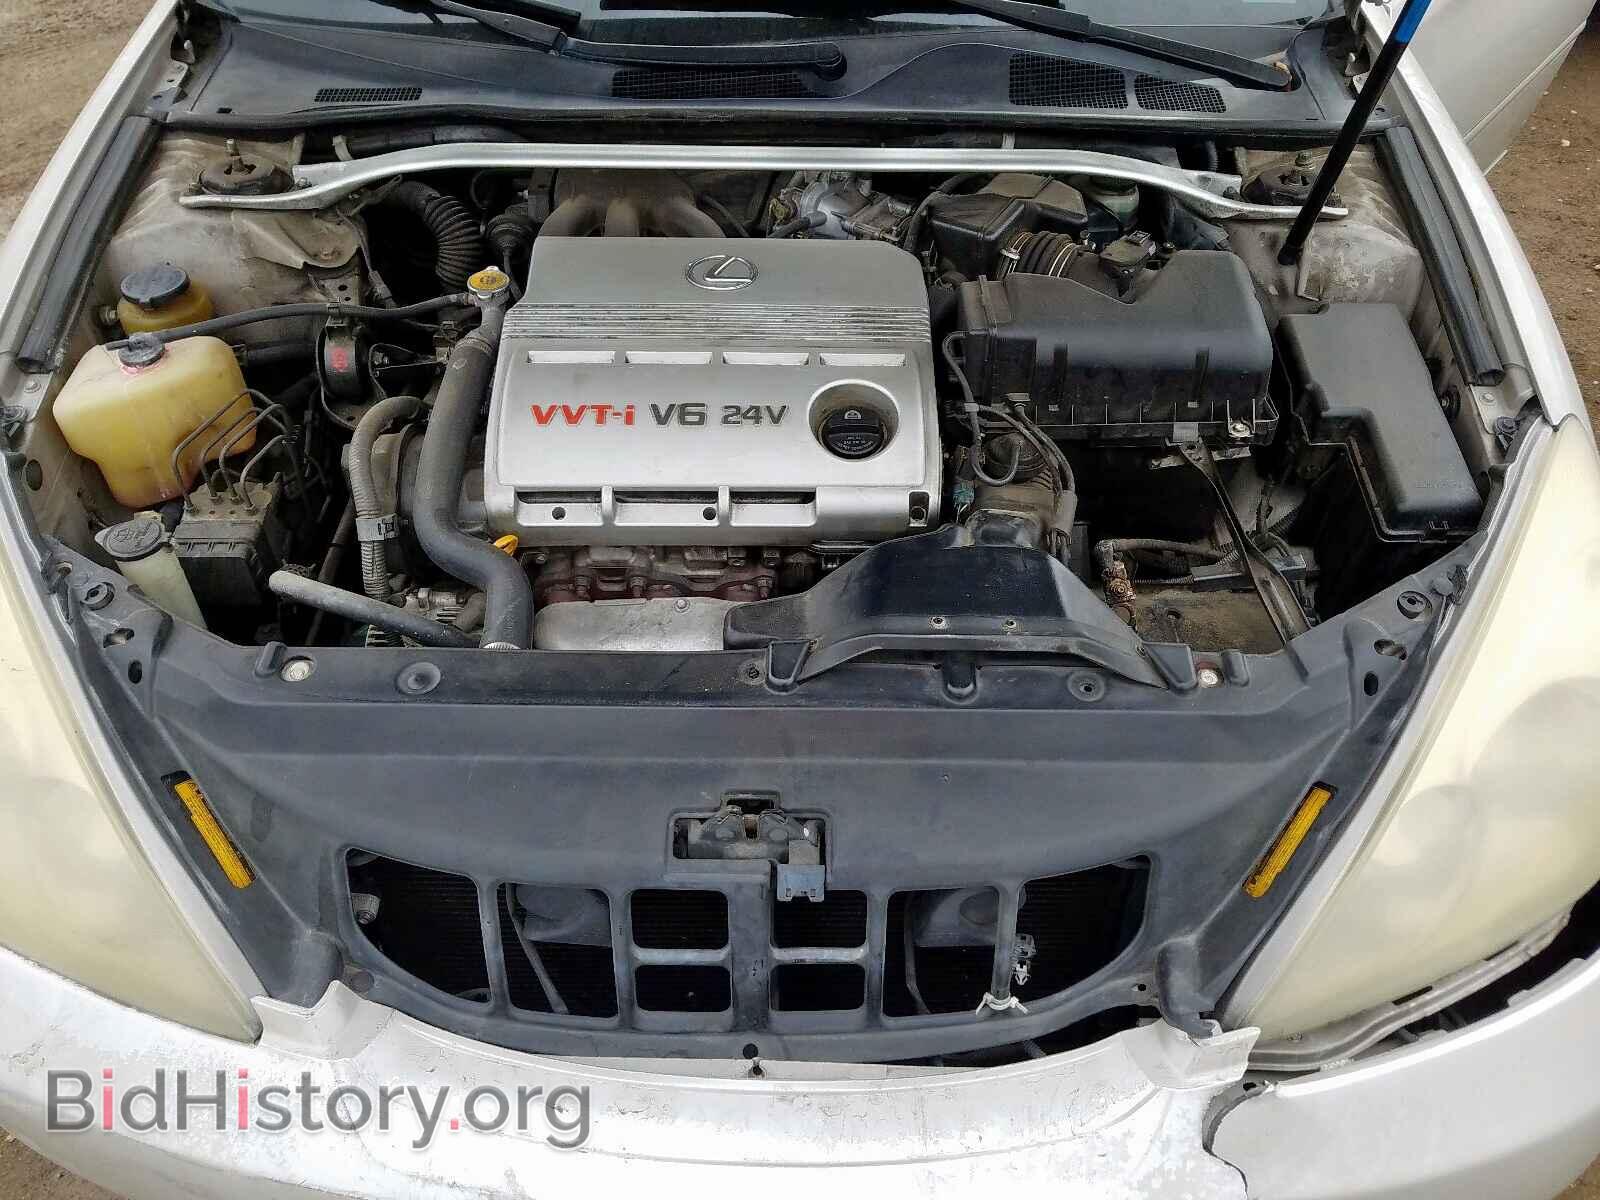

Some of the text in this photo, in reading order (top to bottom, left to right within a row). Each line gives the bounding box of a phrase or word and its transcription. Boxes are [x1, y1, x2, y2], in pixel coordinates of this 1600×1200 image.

[530, 402, 788, 426] VVT-i V6 24V
